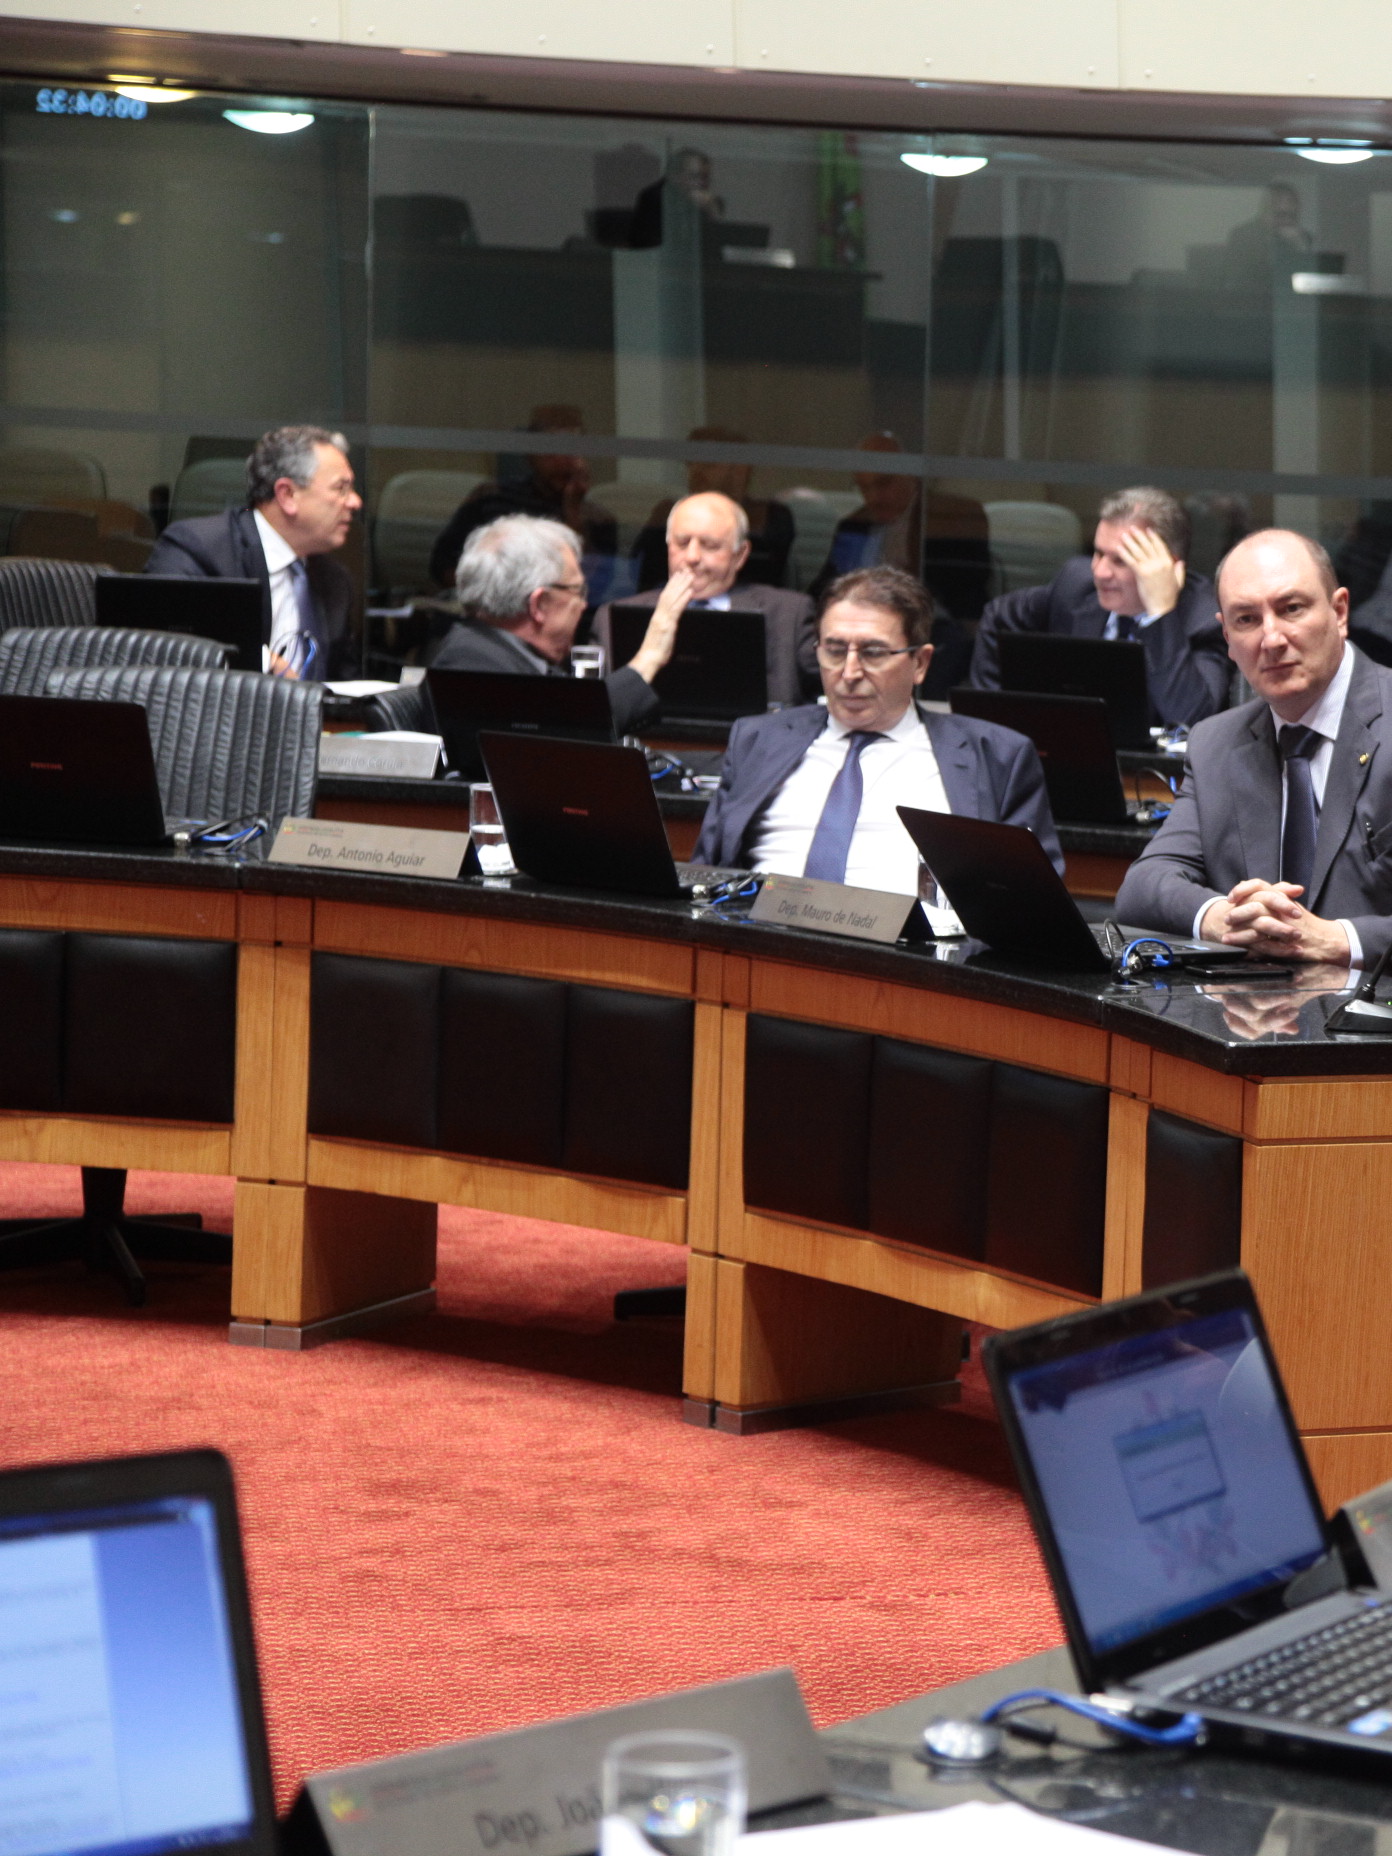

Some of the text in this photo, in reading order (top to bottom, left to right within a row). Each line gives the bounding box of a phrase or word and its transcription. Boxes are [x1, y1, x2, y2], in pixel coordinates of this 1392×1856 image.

[307, 843, 426, 869] Dep. Antonio Aguiar
[777, 900, 878, 930] Dep. Mauro de Nadal
[473, 1806, 550, 1851] Dep.
